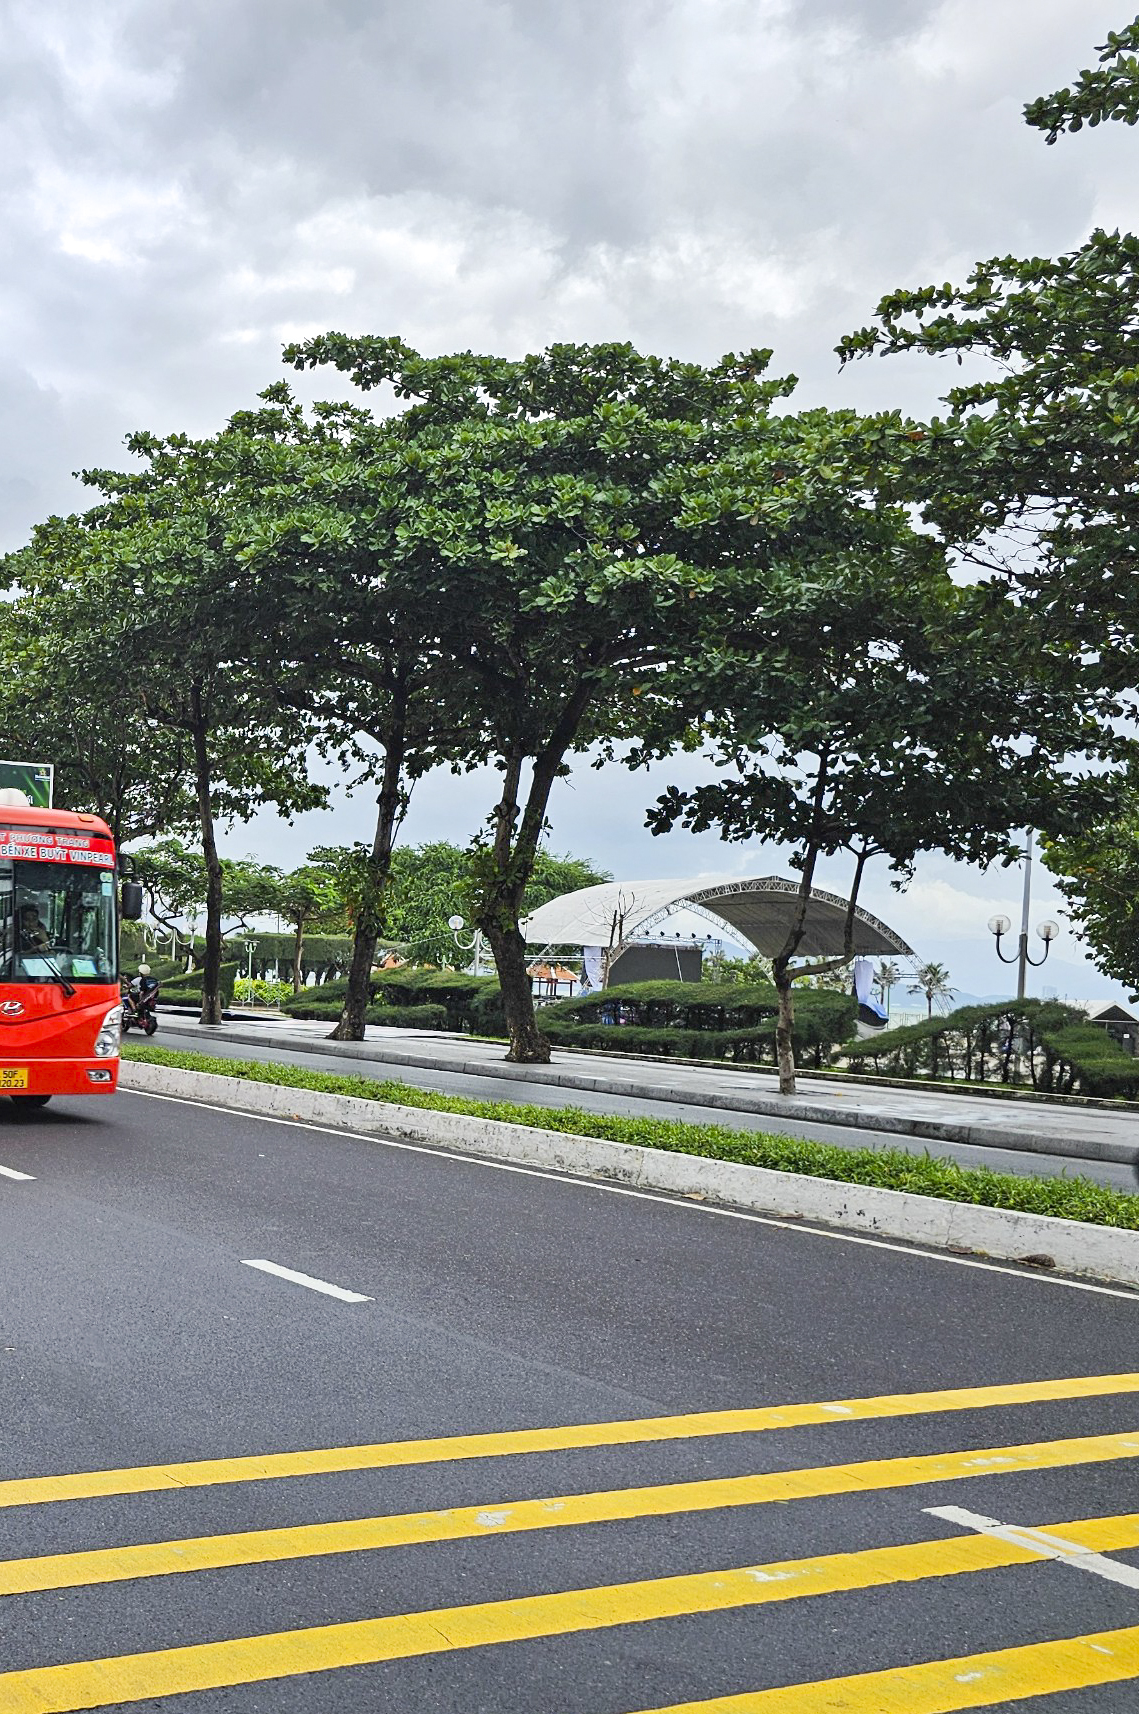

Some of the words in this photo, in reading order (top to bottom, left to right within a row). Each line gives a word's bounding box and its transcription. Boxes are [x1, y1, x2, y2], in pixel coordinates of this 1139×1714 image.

[56, 836, 90, 848] TRANG
[22, 846, 38, 858] XE
[68, 849, 115, 865] VINPEARL
[2, 1070, 18, 1079] 50F
